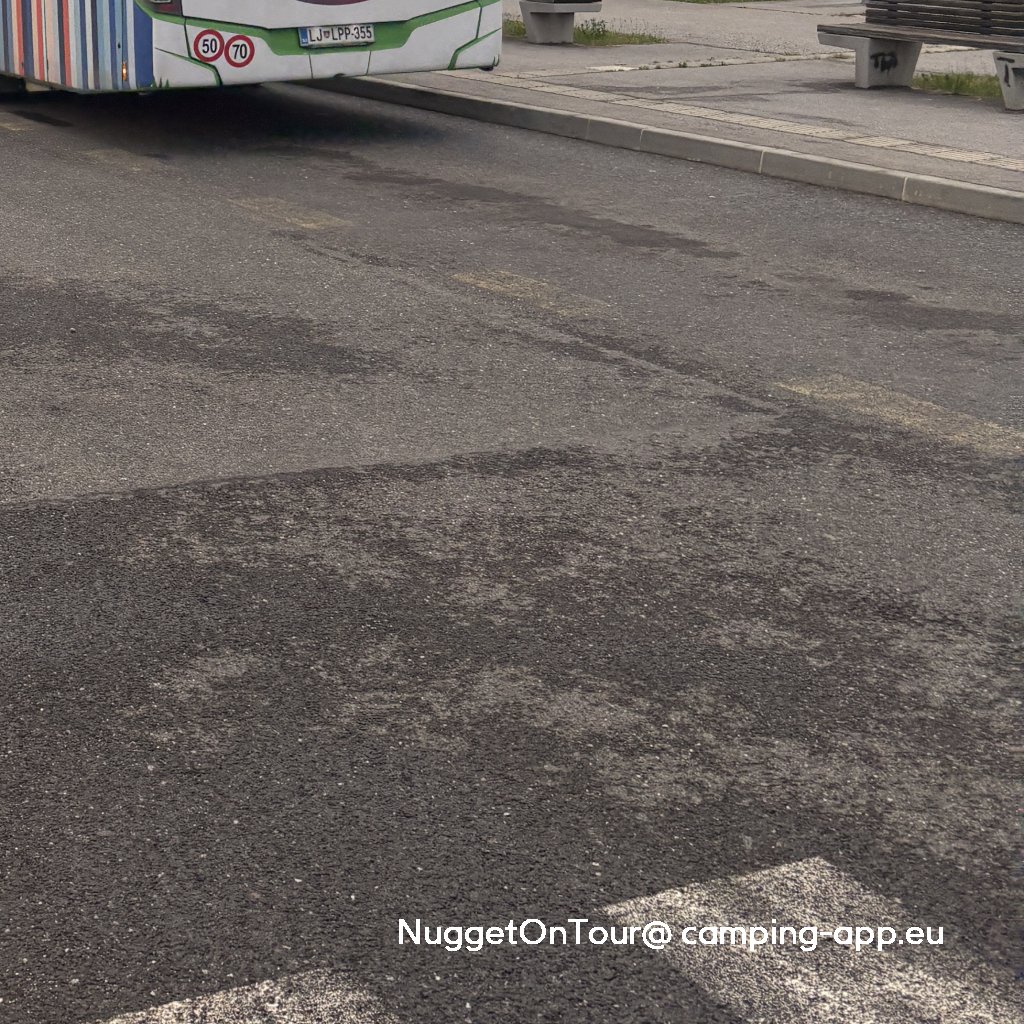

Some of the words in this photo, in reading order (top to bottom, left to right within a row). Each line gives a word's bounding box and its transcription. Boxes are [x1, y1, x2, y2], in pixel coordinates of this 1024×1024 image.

[309, 28, 323, 43] LJ
[331, 26, 372, 42] LPP-355
[202, 38, 218, 54] 50
[232, 43, 248, 60] 70
